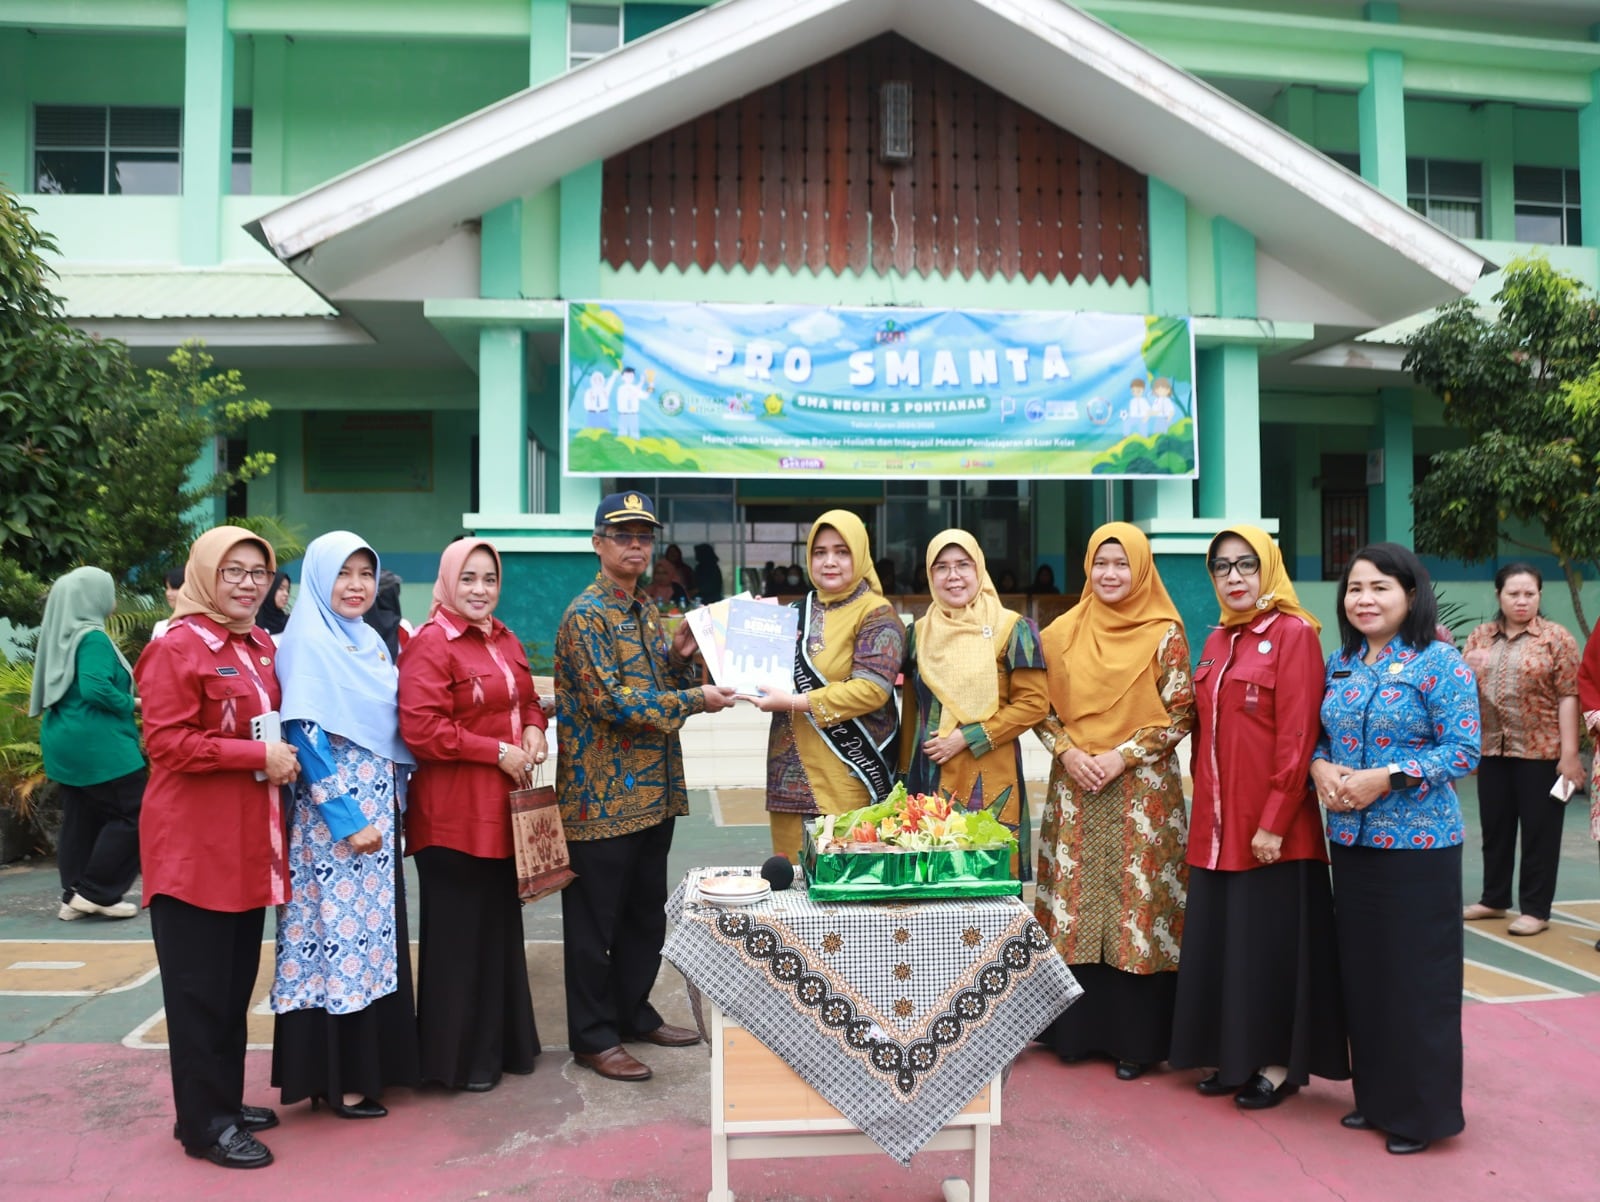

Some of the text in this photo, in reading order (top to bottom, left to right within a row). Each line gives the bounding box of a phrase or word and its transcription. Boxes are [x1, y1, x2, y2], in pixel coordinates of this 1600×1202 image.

[705, 337, 1070, 387] PRO SMANTA
[797, 394, 986, 413] SMA NEGERI 3 PONTIANAK
[760, 436, 811, 448] Lingkungan
[812, 437, 842, 448] Belajar
[843, 437, 875, 446] Holistik
[877, 437, 893, 446] dan
[967, 438, 1023, 448] Pembelajaran
[1034, 438, 1052, 447] Luar
[794, 644, 813, 693] unda
